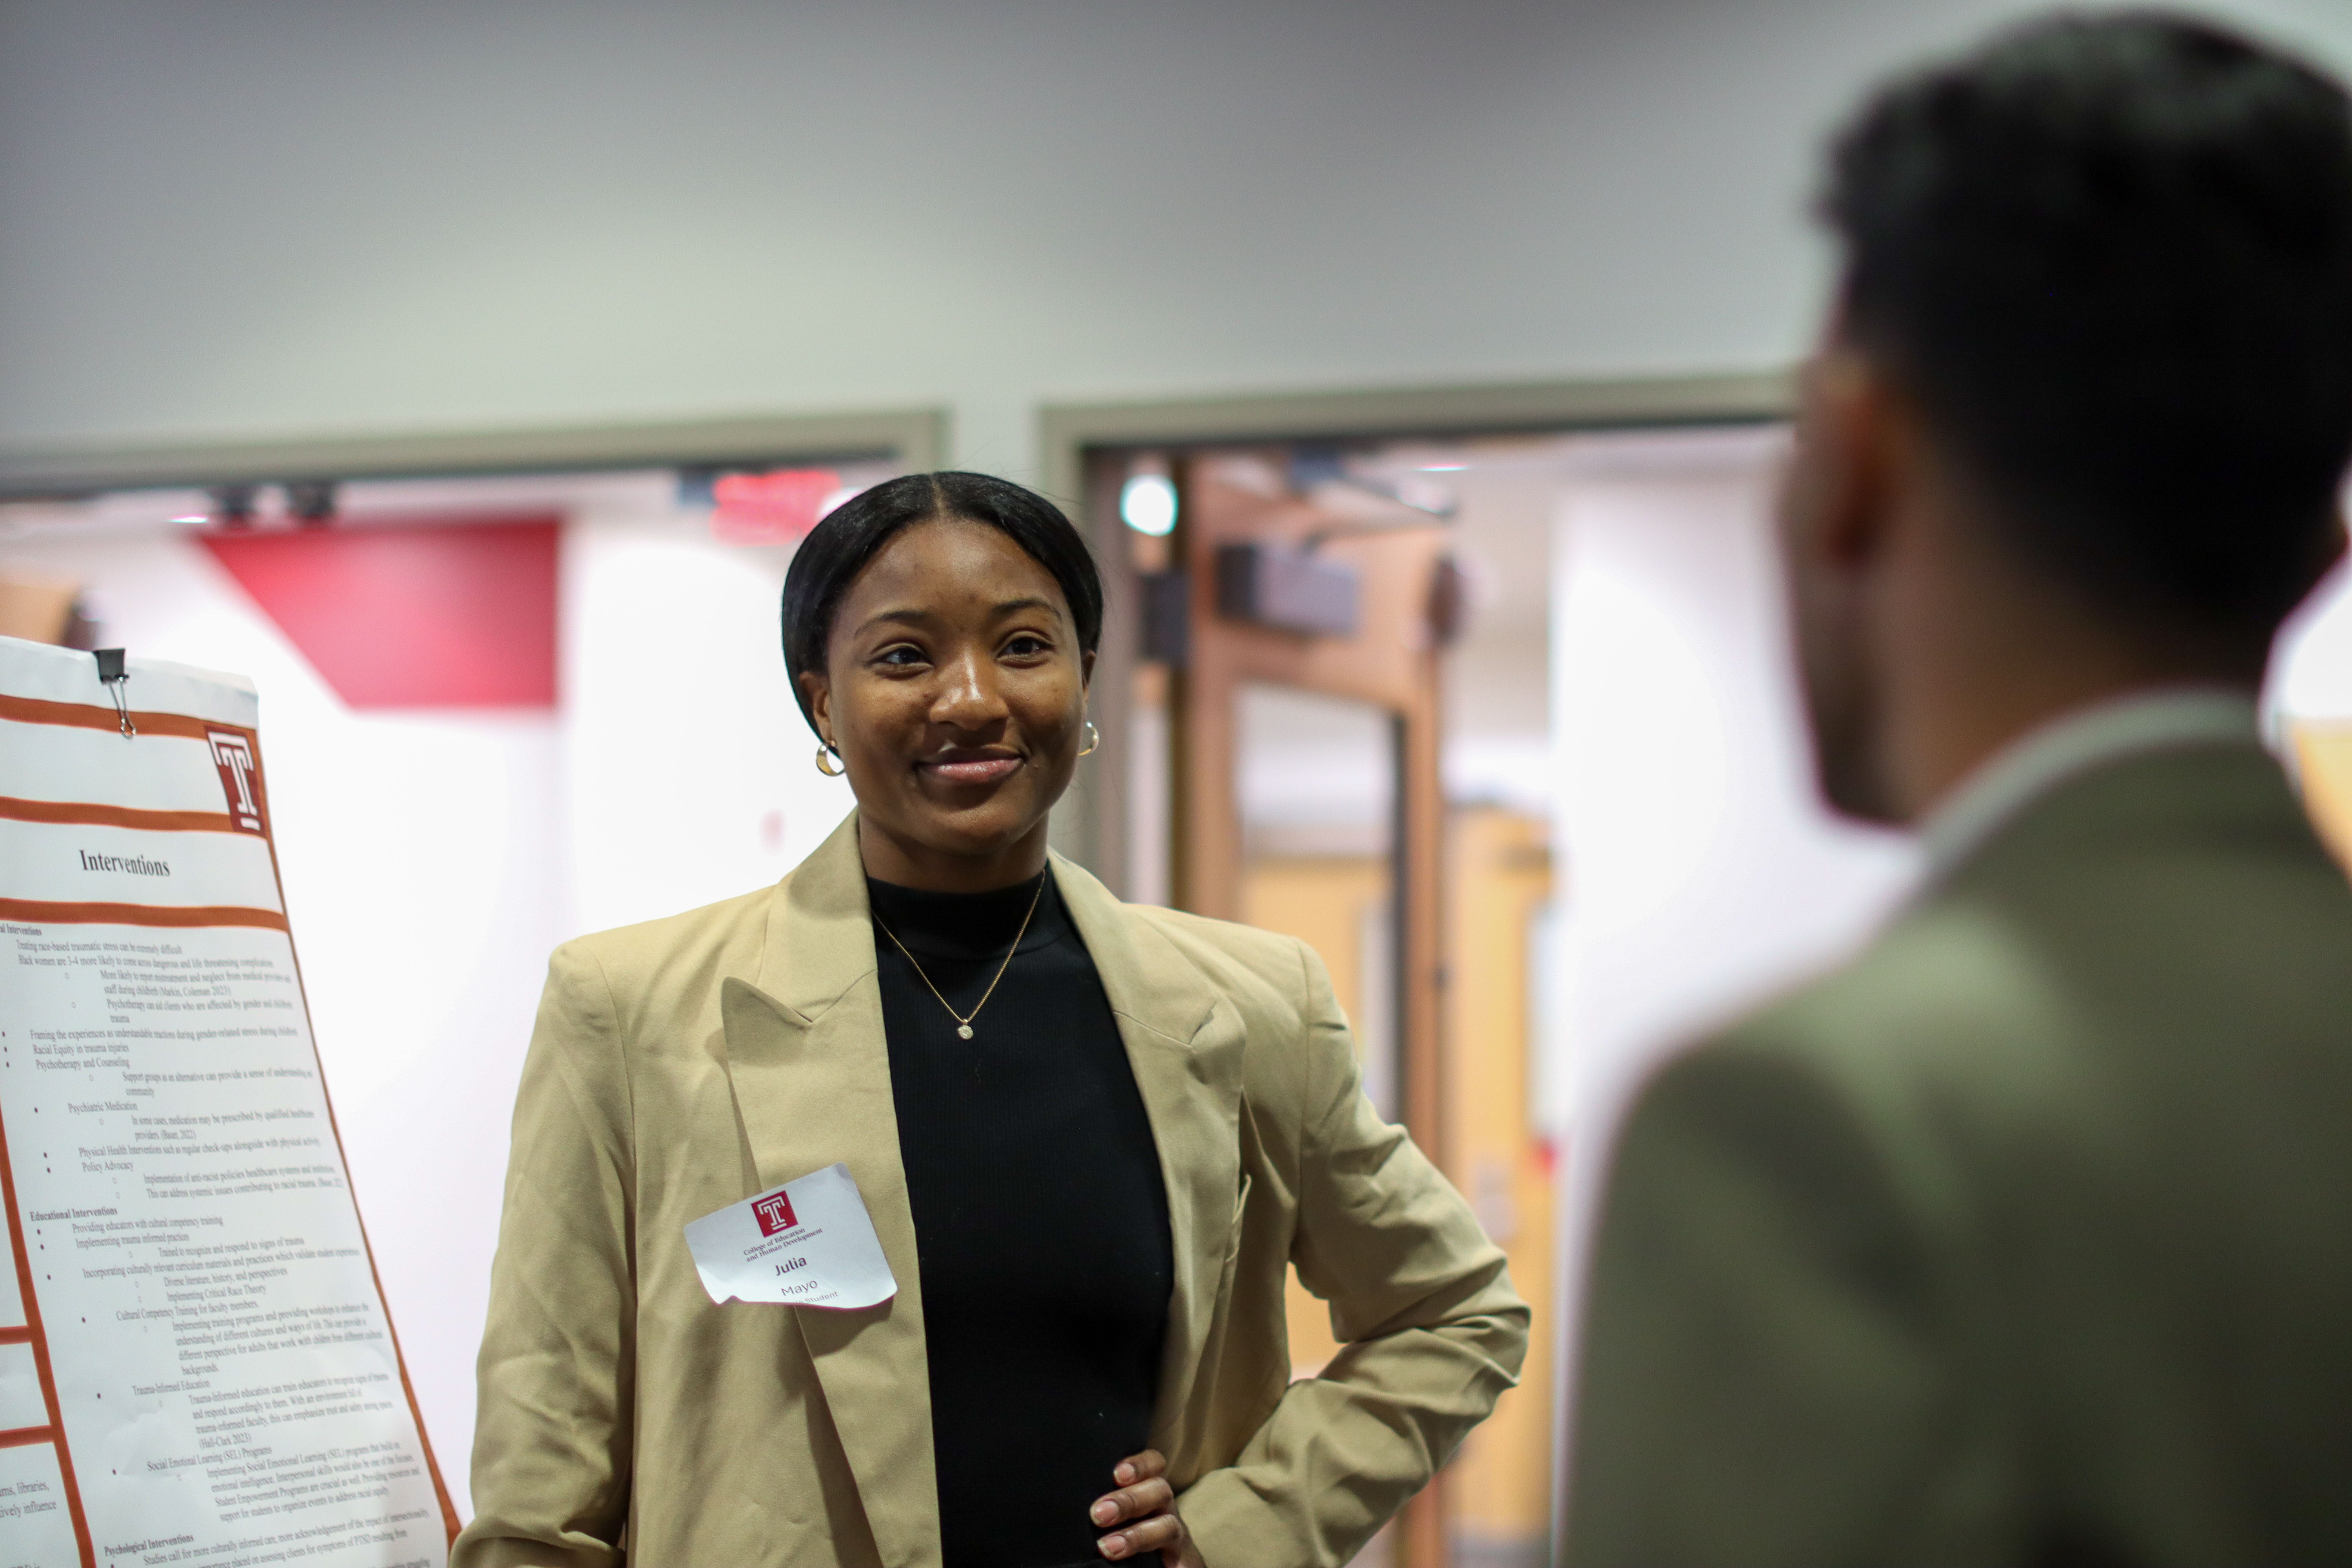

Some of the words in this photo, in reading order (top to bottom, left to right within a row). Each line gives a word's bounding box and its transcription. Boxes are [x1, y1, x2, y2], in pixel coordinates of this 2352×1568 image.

[208, 732, 261, 831] T
[79, 849, 170, 877] Interventions
[6, 924, 42, 936] Interventions
[30, 1209, 71, 1221] Educational
[72, 1207, 117, 1217] Interventions
[757, 1196, 787, 1230] T
[744, 1244, 766, 1255] College
[774, 1228, 805, 1243] Education
[746, 1254, 759, 1262] and
[759, 1245, 782, 1257] Human
[783, 1228, 823, 1247] Development
[775, 1257, 807, 1276] Julia
[781, 1280, 818, 1296] Mayo
[805, 1291, 838, 1303] Student
[17, 1481, 49, 1494] libraries,
[24, 1501, 56, 1514] influence
[105, 1541, 147, 1556] Psychological
[148, 1534, 193, 1548] Interventions
